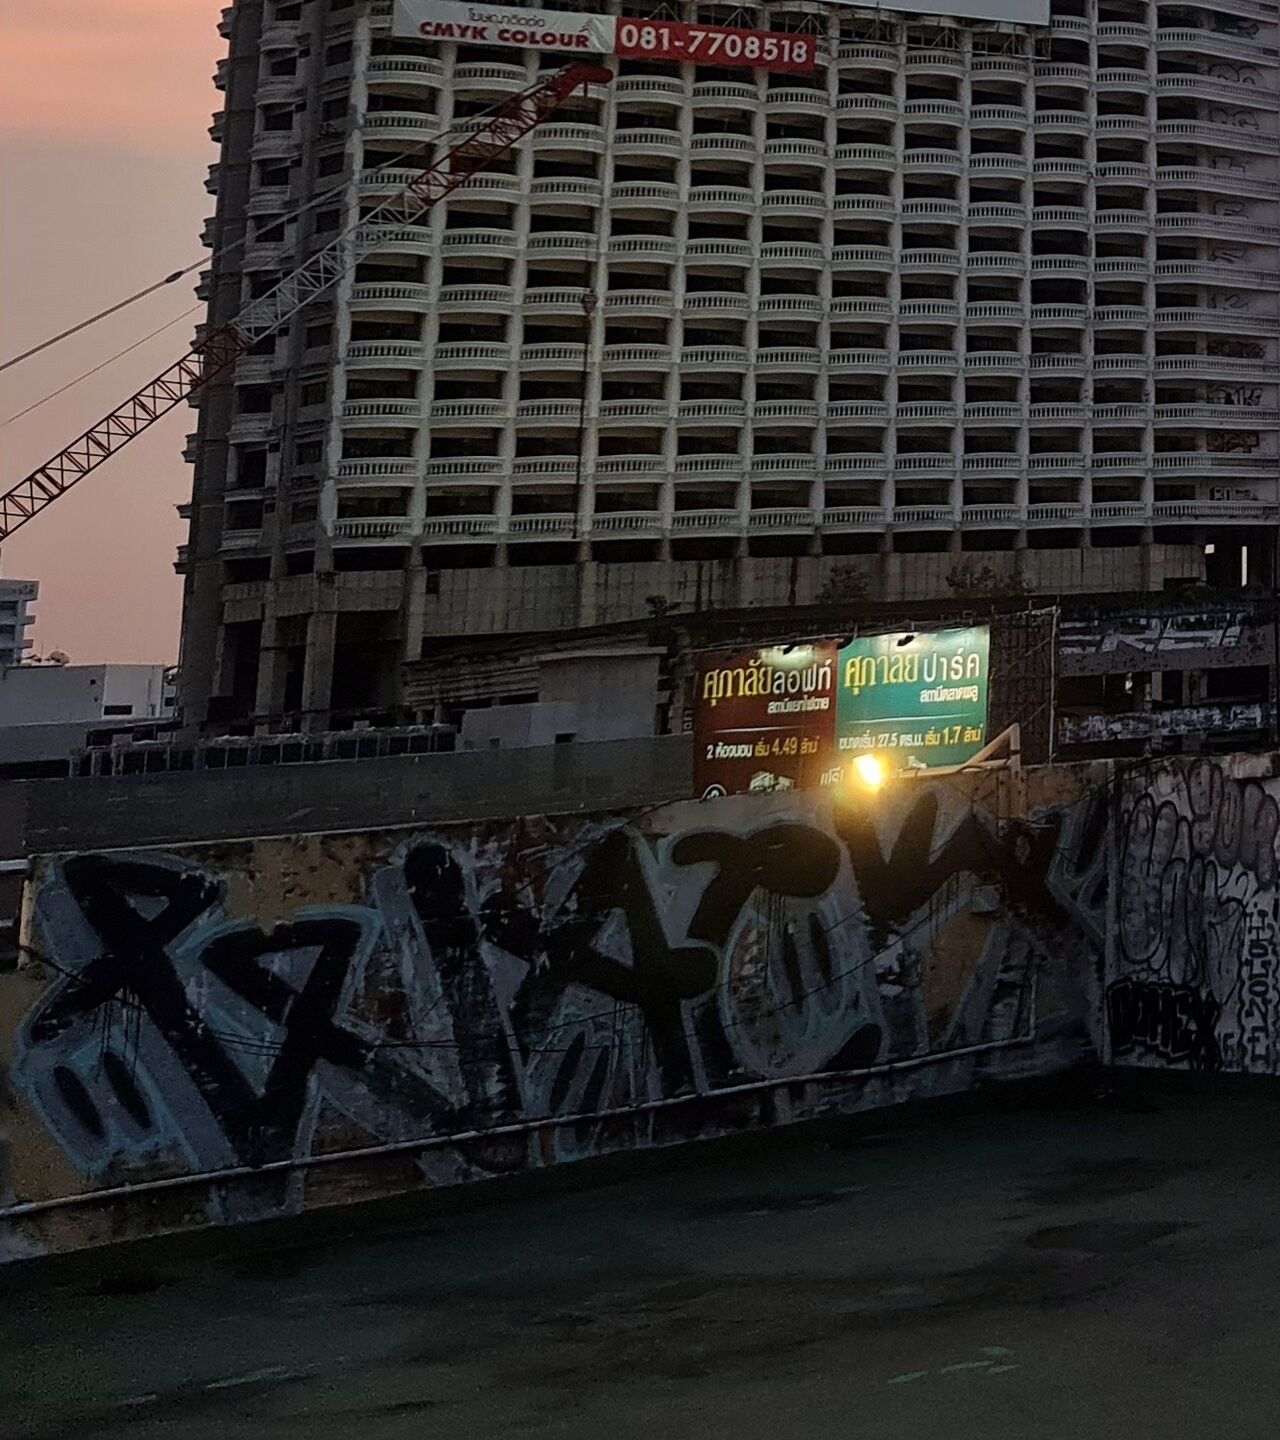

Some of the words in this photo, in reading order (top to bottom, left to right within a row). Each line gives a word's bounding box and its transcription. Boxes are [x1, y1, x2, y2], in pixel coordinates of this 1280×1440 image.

[419, 20, 488, 41] CMYK
[496, 28, 591, 49] COLOUR
[620, 23, 808, 63] 081-7708518
[707, 744, 714, 759] 2
[772, 737, 797, 756] 4.49
[878, 733, 898, 747] 27.5
[942, 726, 962, 745] 1.7
